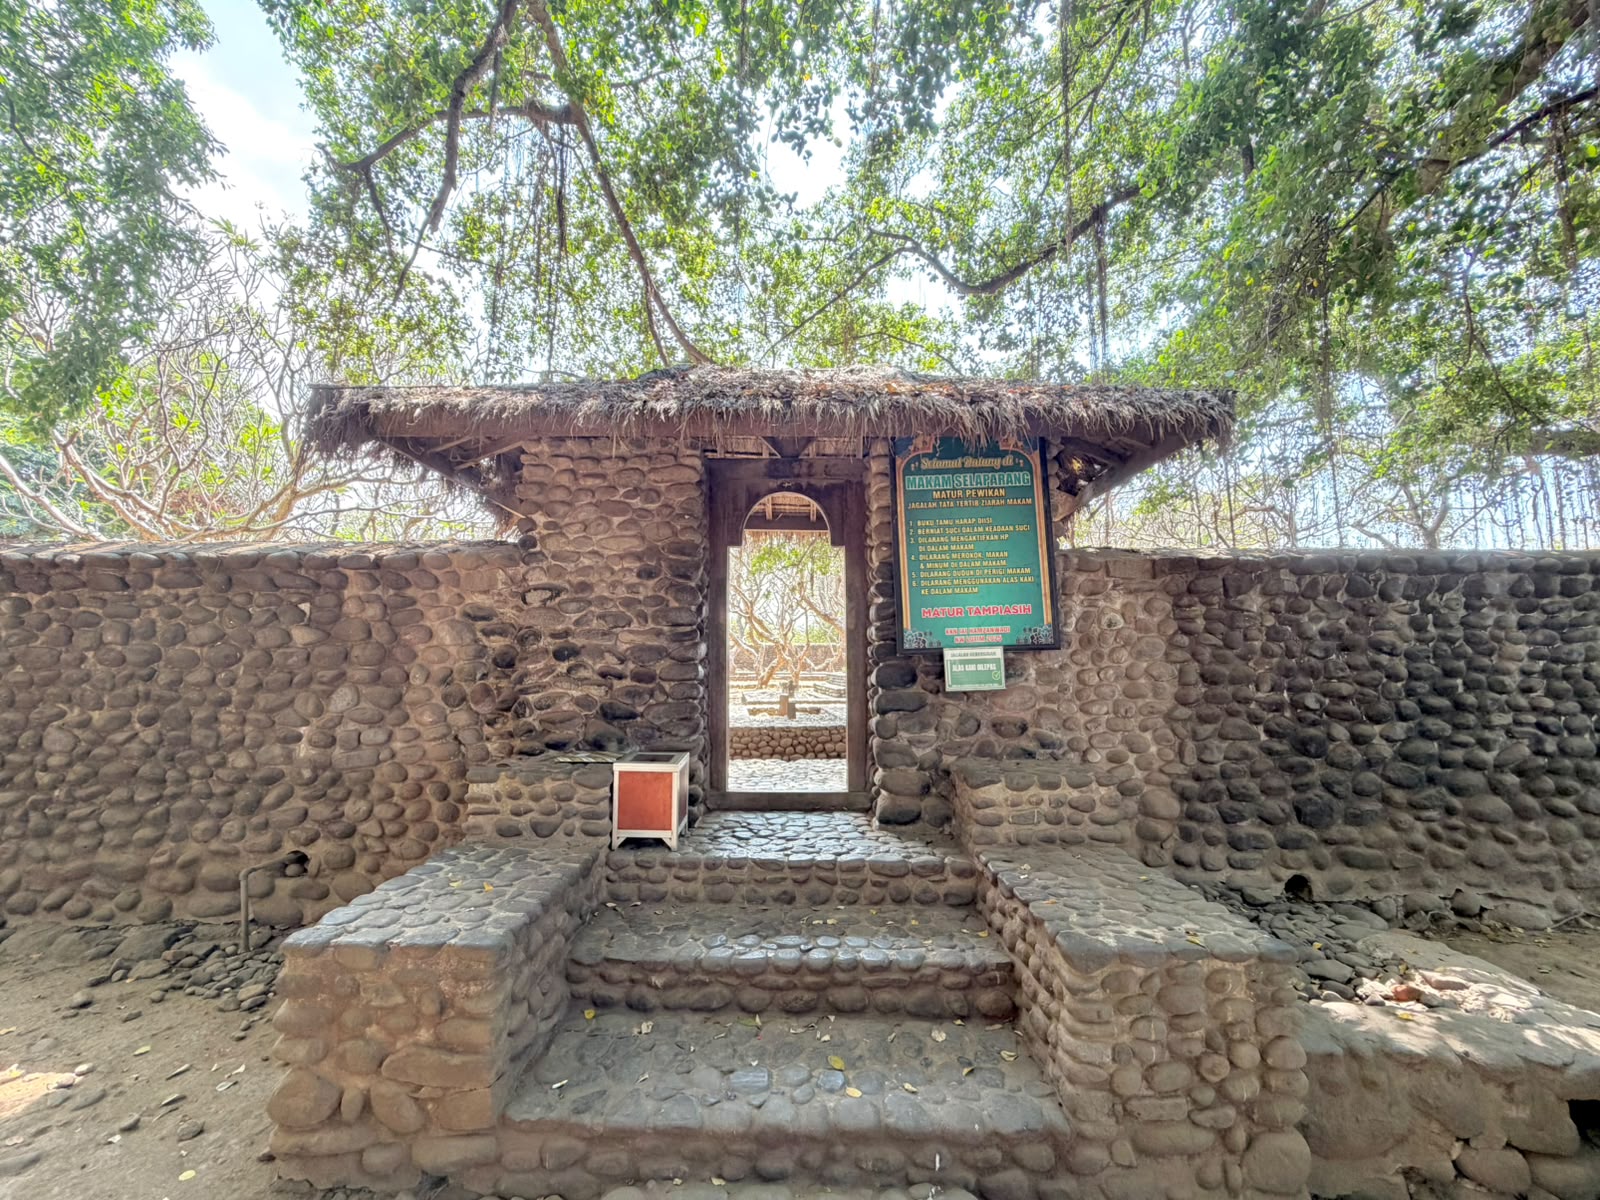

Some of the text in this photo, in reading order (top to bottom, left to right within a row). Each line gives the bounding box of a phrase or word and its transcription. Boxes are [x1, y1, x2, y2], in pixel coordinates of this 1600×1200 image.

[1002, 455, 1013, 466] di
[906, 472, 1030, 490] MAKAM SELAPARANG
[932, 488, 1006, 499] MATUR PEWIKAN
[954, 578, 1001, 586] MENGGUNAKAN
[922, 604, 1032, 618] MATUR TAMPIASIH
[970, 626, 1010, 634] HAMZANWADI
